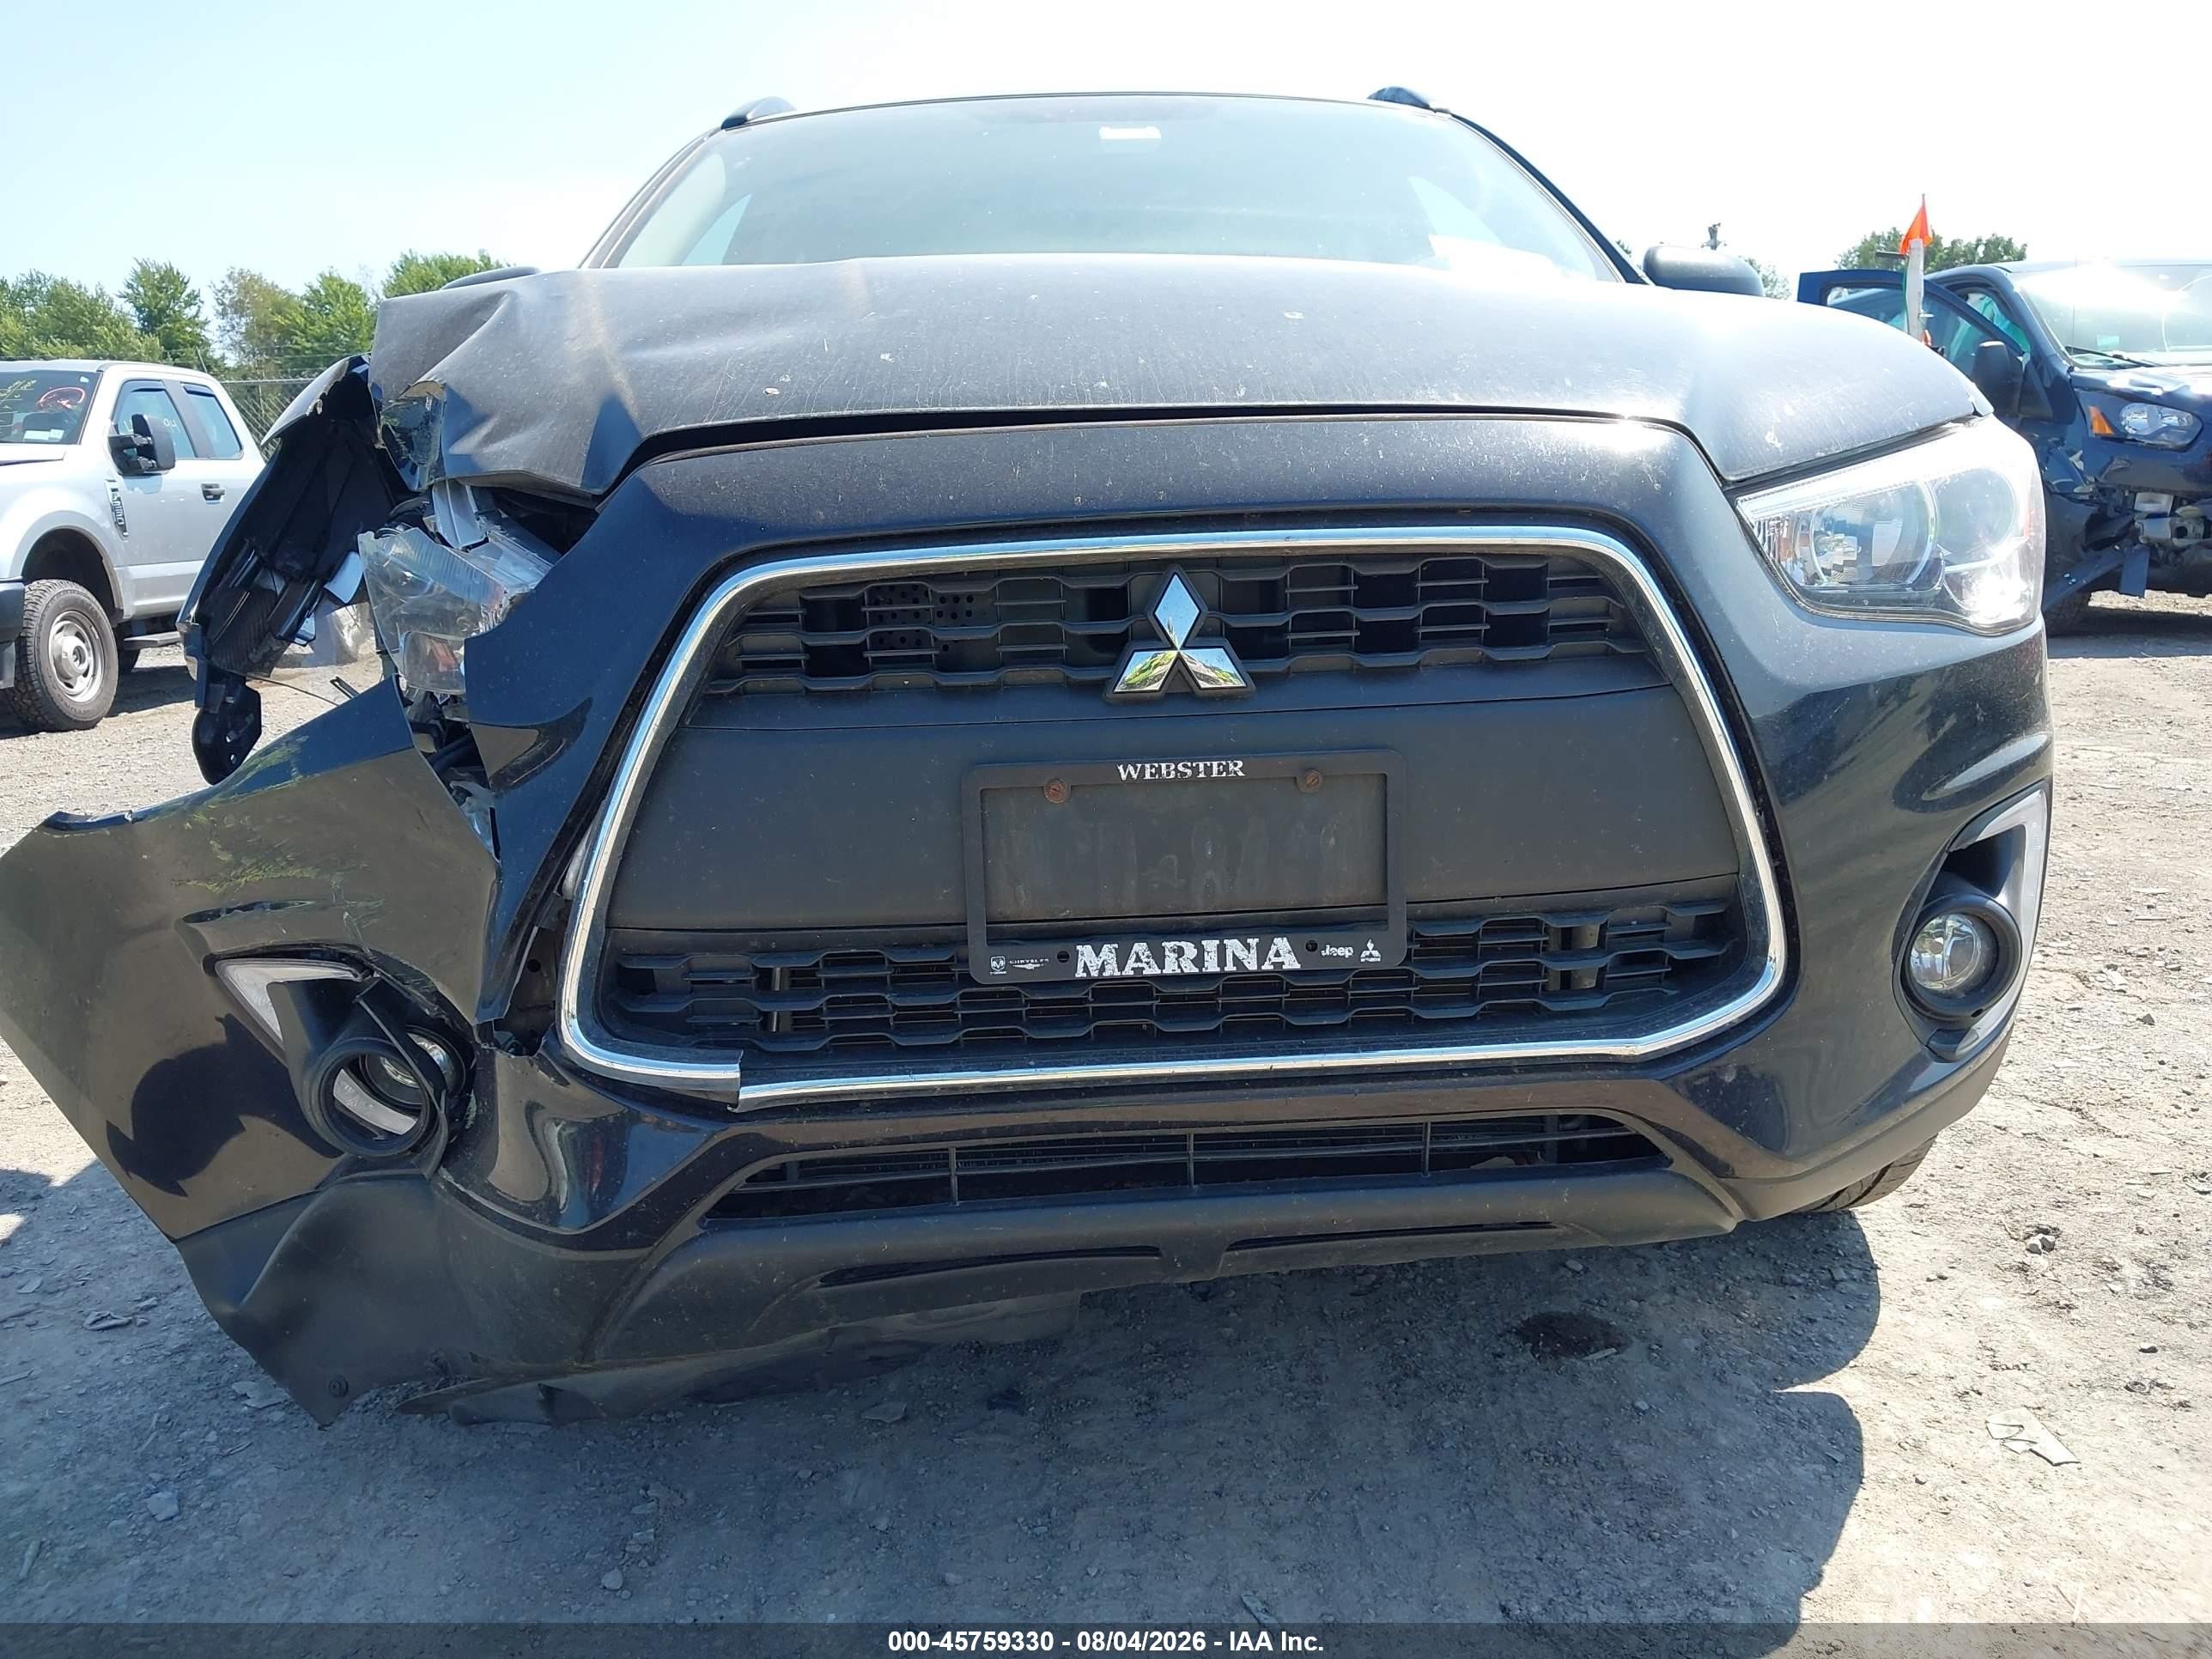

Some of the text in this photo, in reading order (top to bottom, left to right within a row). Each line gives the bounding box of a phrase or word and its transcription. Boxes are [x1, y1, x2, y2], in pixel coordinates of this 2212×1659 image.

[1117, 760, 1246, 781] WEBSTER
[1075, 937, 1301, 977] MARINA
[1321, 944, 1354, 958] Jeep
